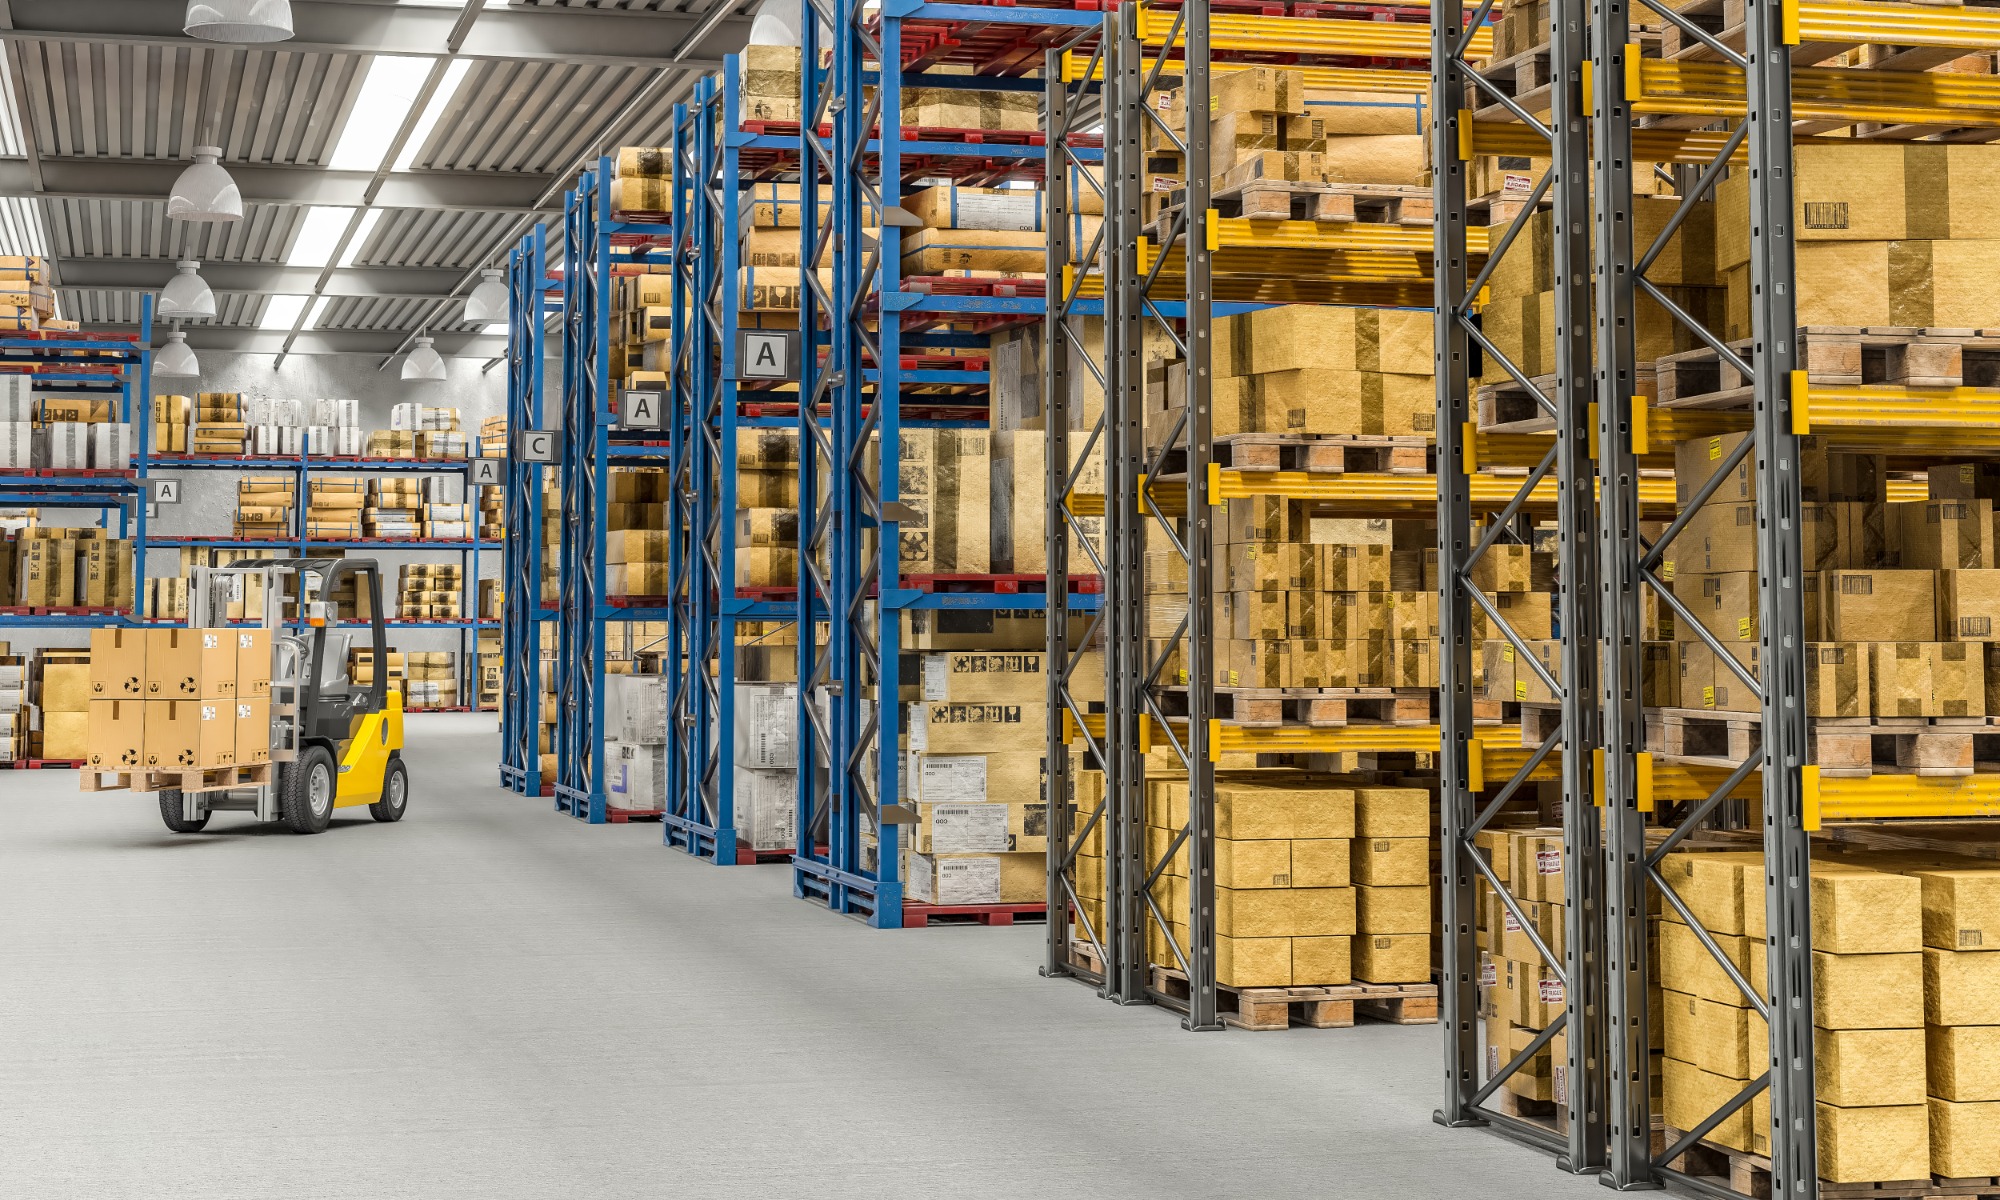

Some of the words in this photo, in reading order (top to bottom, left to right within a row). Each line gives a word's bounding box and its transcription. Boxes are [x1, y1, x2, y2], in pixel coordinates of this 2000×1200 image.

[755, 341, 777, 366] A
[634, 398, 651, 419] A
[532, 437, 545, 455] C
[480, 463, 493, 478] A
[161, 484, 172, 498] A
